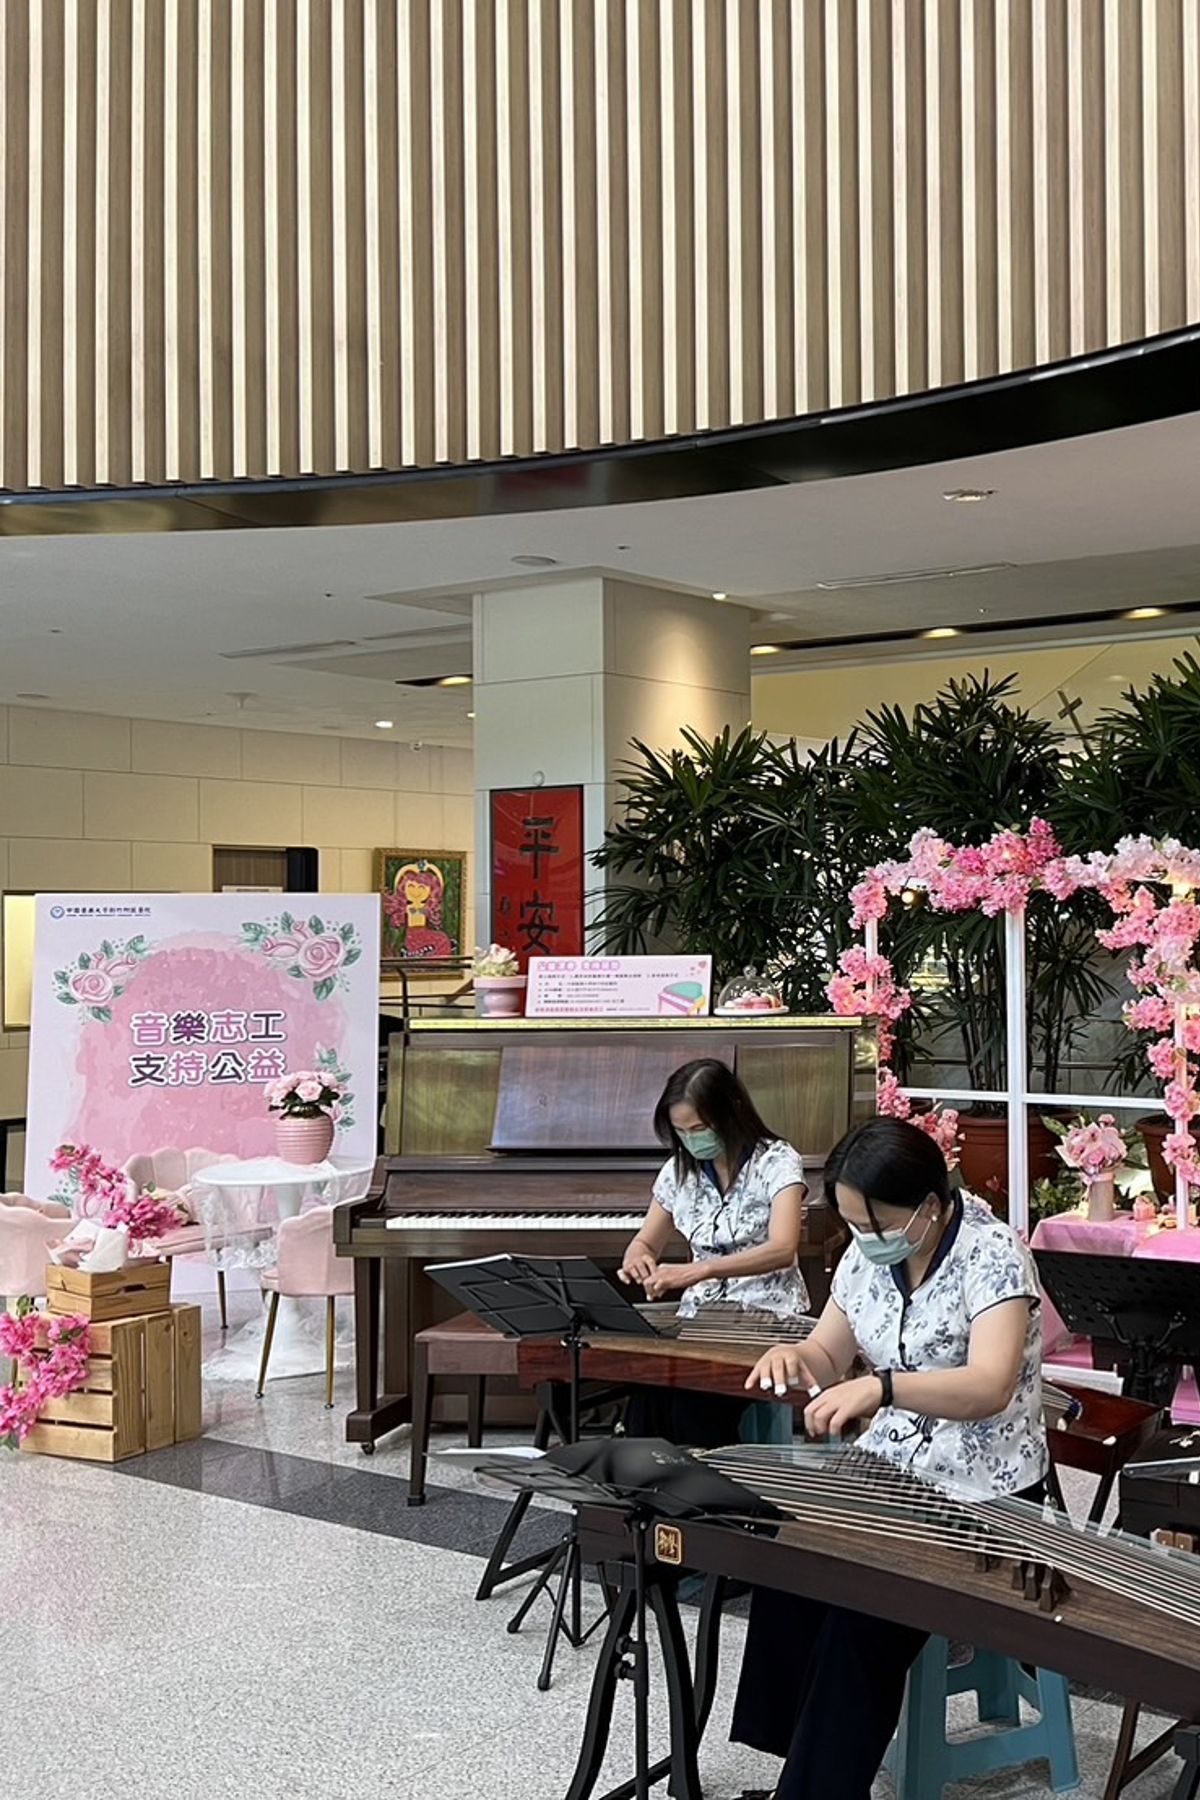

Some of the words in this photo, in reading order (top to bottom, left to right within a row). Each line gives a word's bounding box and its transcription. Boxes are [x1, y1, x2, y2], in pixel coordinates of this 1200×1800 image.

[517, 816, 559, 955] 平安
[131, 1009, 286, 1045] 音樂志工
[130, 1050, 286, 1085] 支持公益
